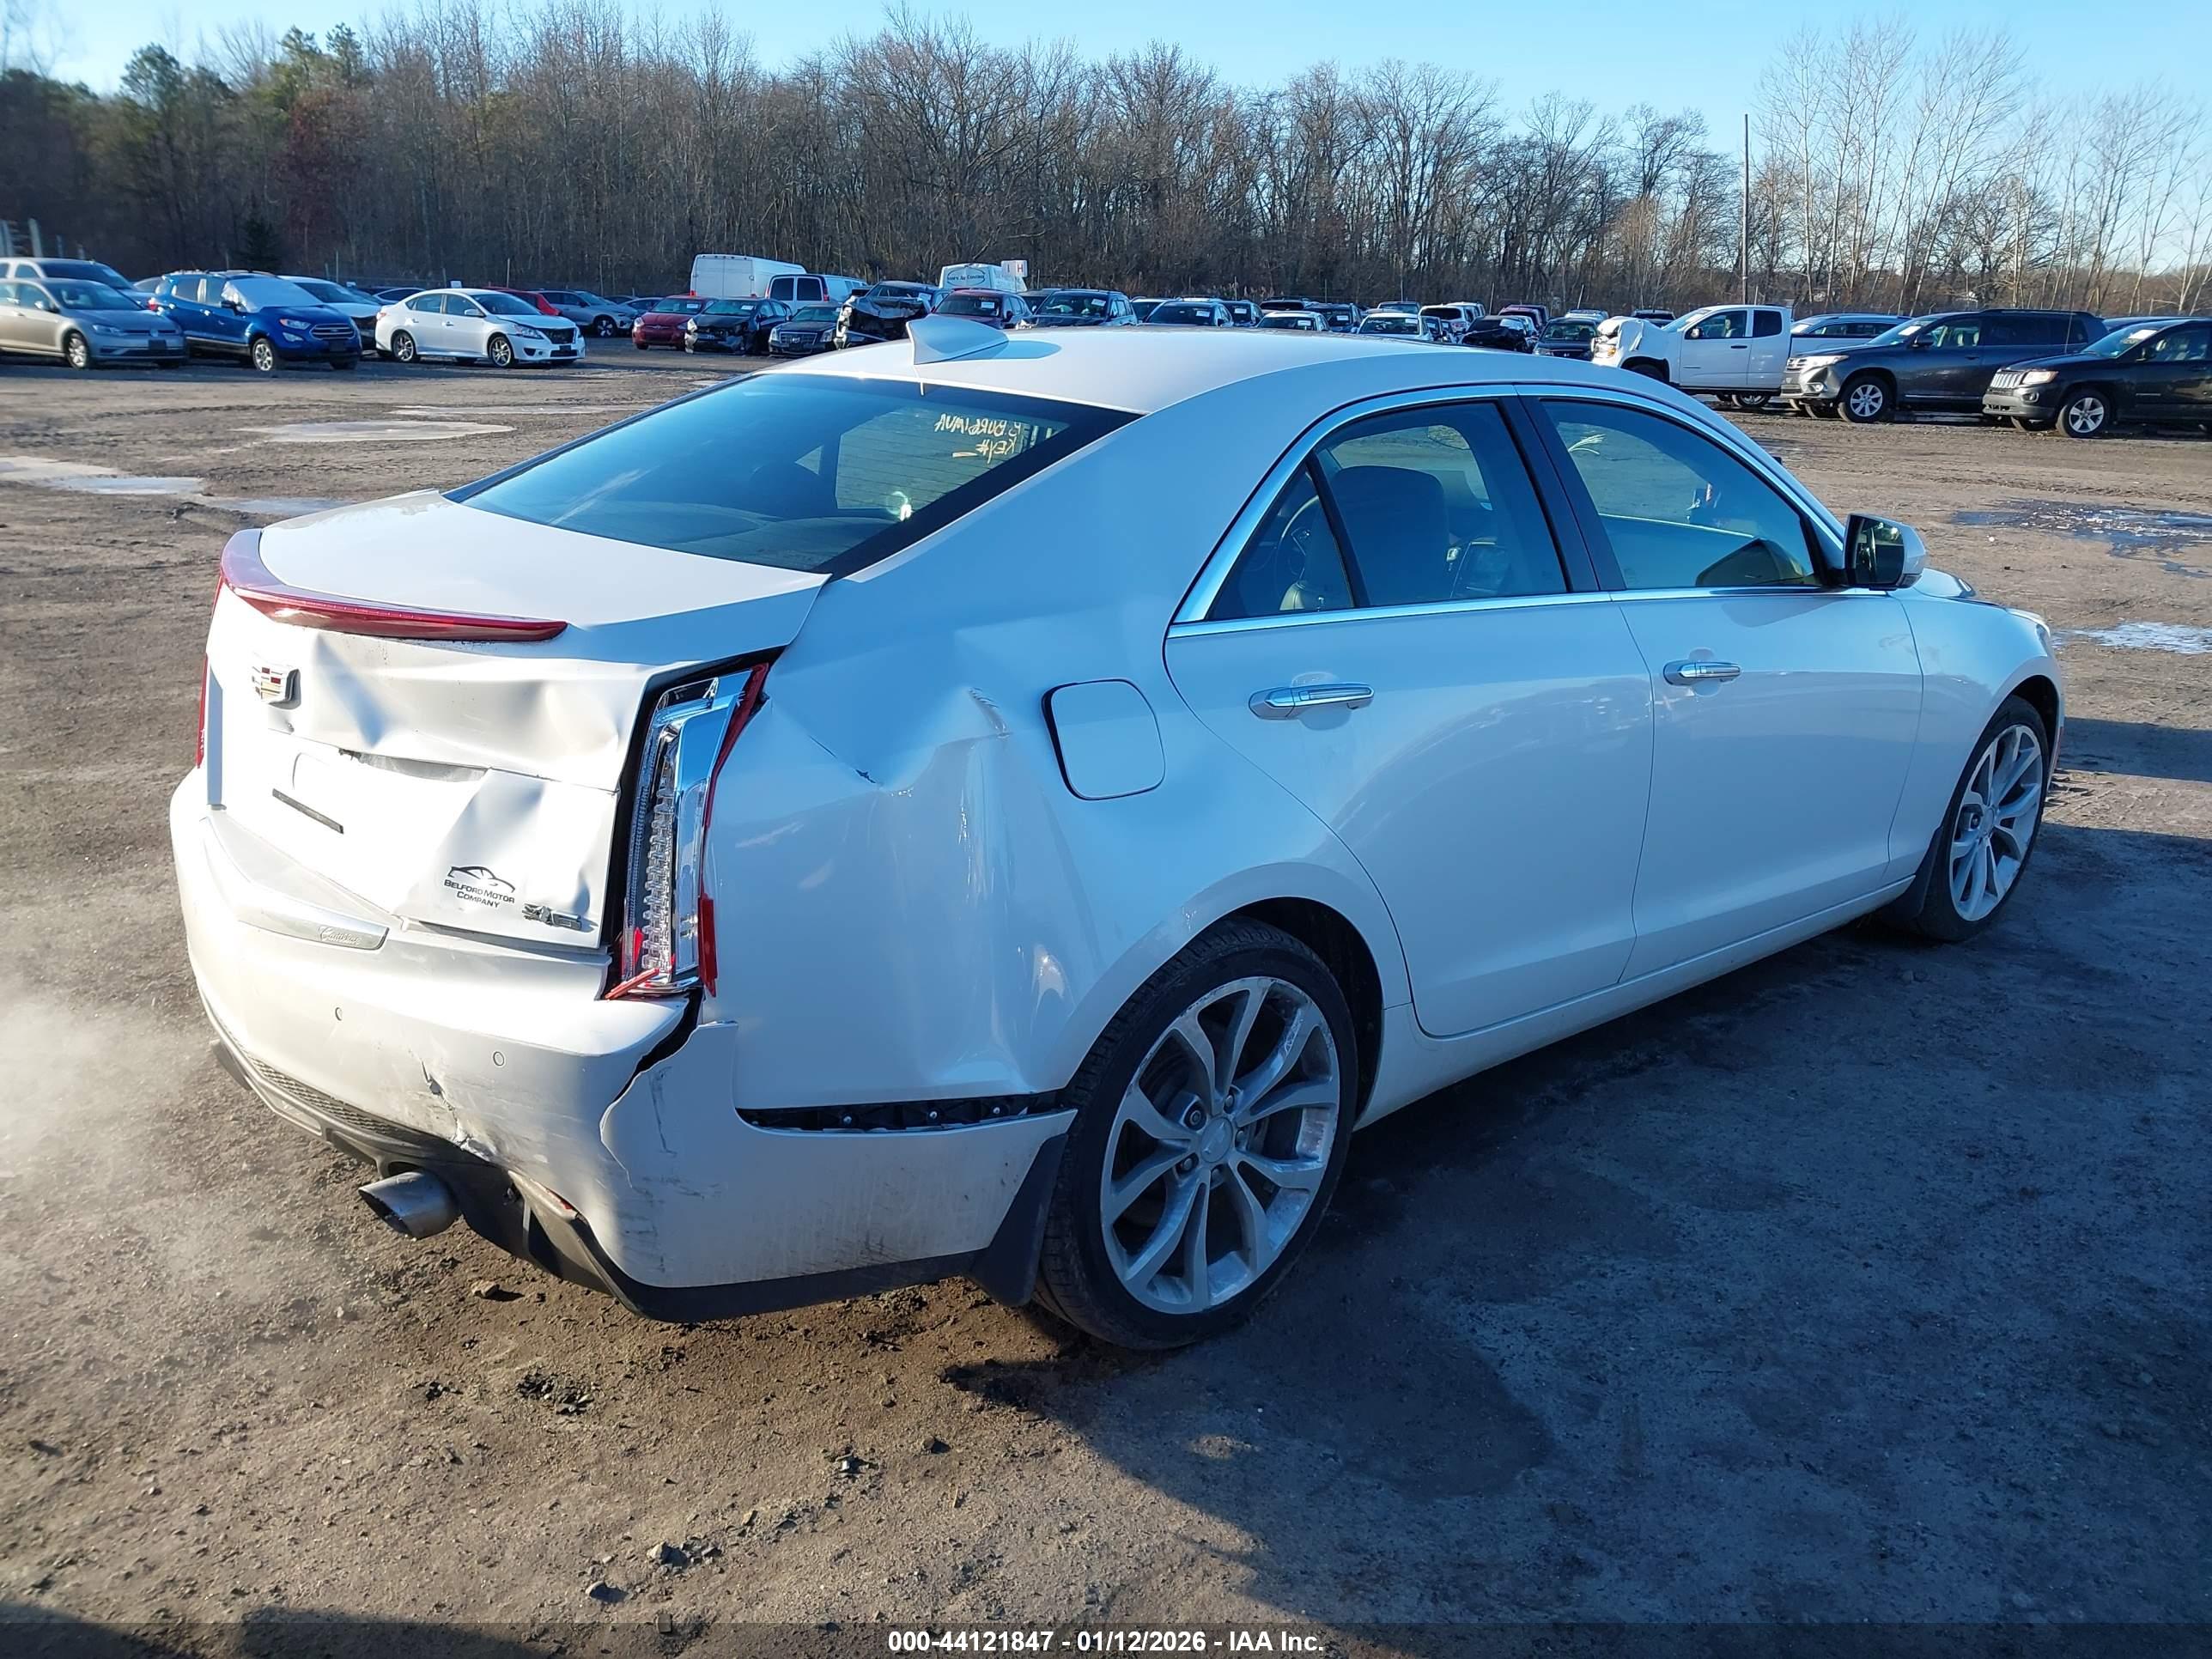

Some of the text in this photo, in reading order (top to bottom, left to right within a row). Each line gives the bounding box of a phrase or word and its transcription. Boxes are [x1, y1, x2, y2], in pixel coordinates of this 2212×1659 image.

[1018, 264, 1024, 272] H
[444, 879, 515, 903] BELFORD MOTOR
[457, 890, 500, 908] COMPANY
